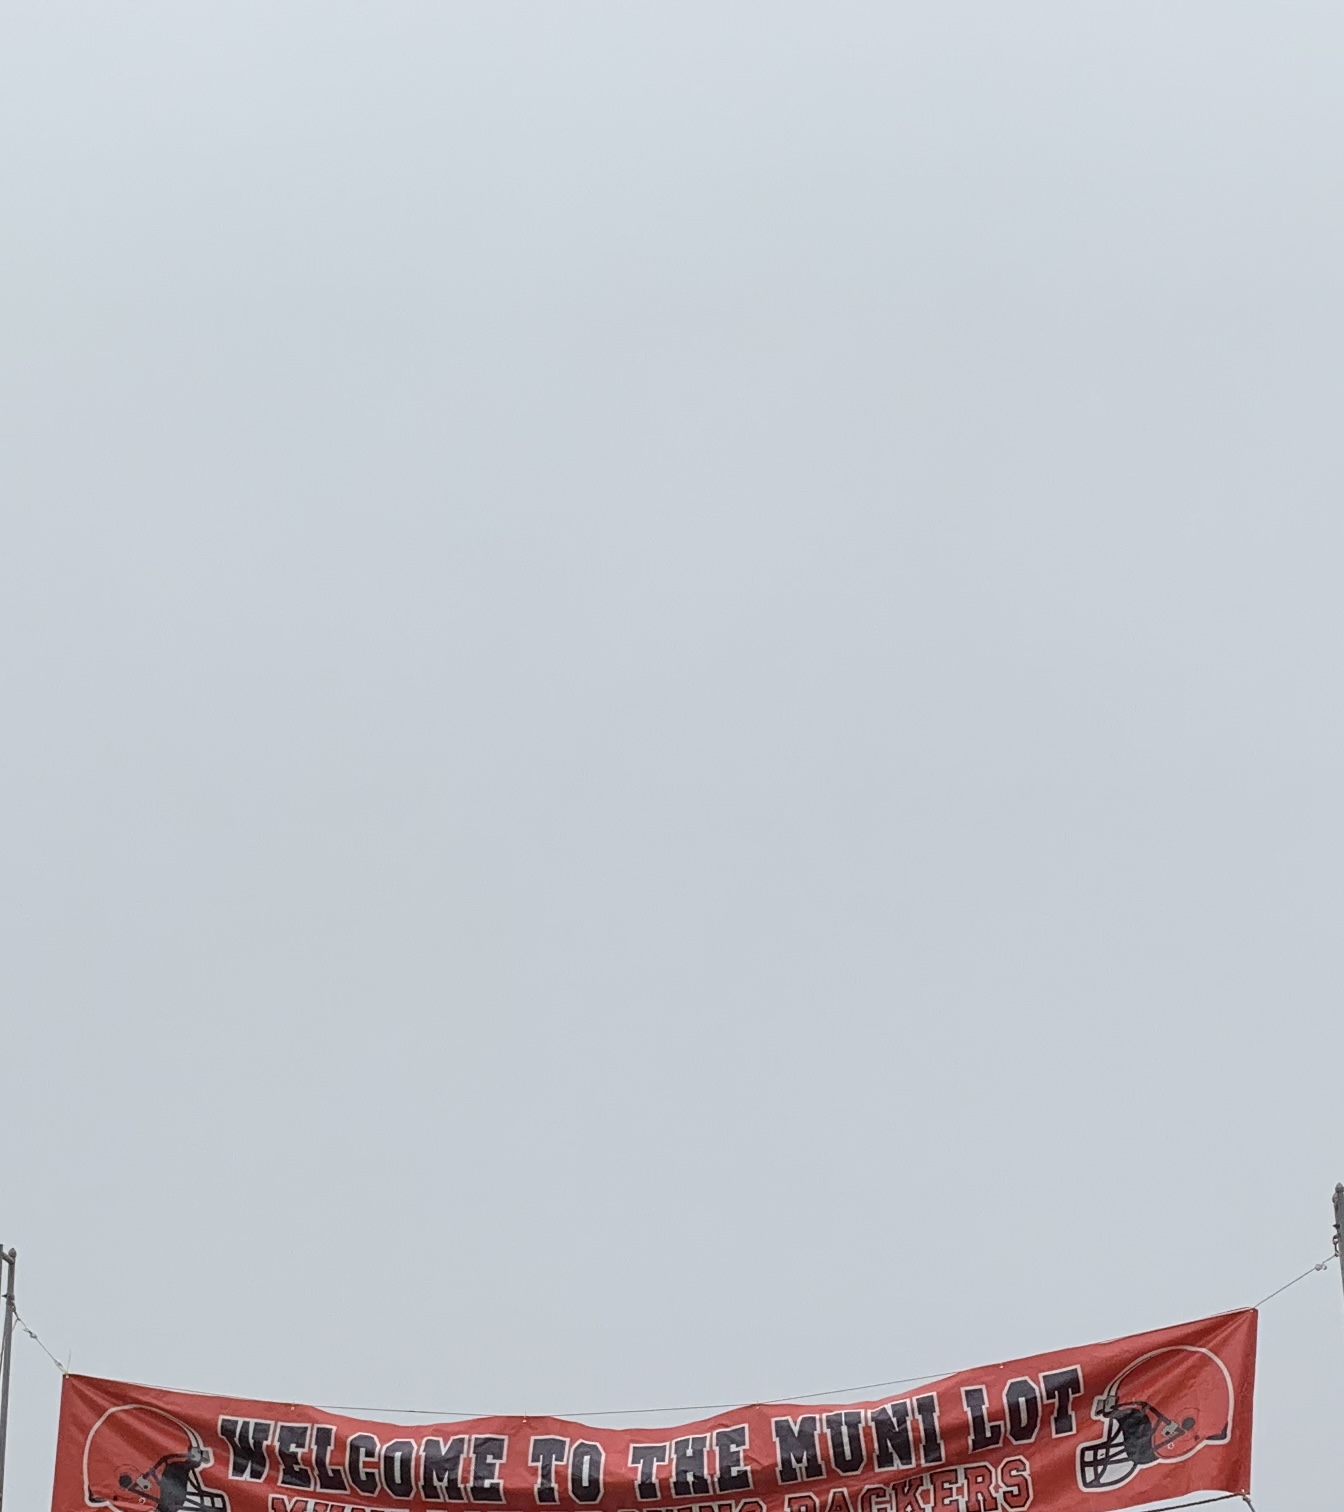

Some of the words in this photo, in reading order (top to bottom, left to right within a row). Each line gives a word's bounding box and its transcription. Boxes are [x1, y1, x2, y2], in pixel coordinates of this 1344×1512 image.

[217, 1414, 509, 1504] WELCOME
[527, 1434, 606, 1505] TO
[627, 1422, 754, 1502] THE
[770, 1391, 947, 1486] MUNI
[960, 1363, 1085, 1455] LOT
